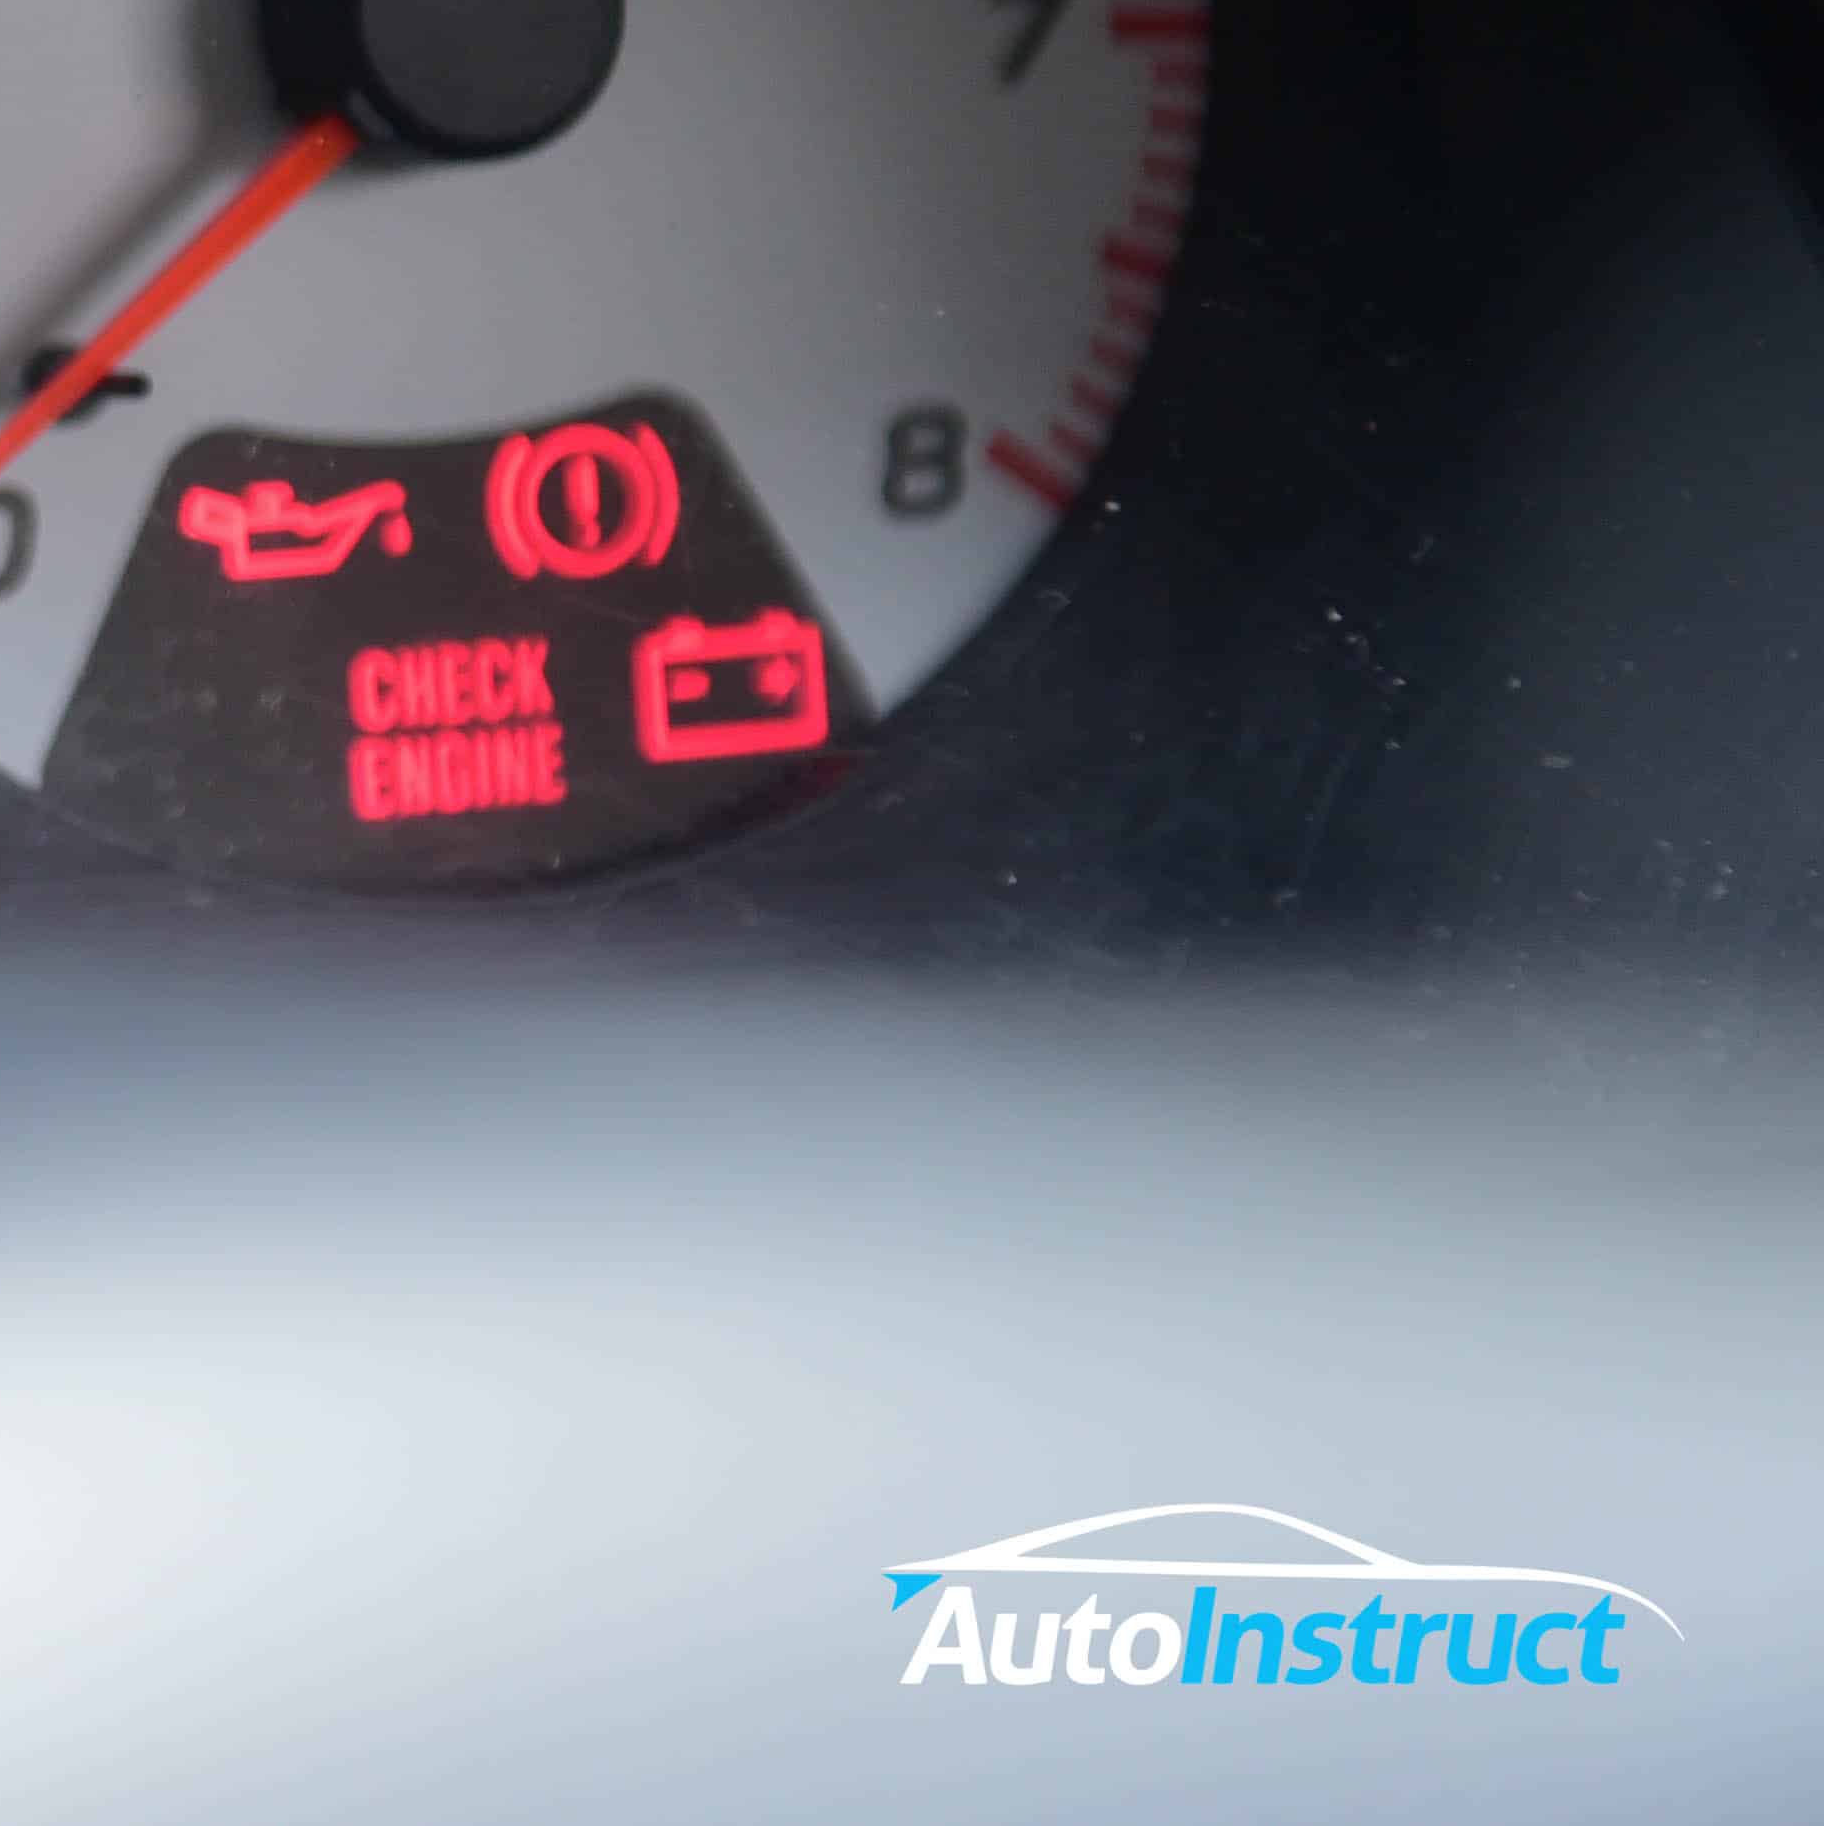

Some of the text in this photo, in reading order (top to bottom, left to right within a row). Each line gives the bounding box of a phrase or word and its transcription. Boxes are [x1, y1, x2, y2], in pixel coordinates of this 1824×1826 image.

[882, 405, 967, 514] 8
[349, 637, 553, 733] CHECK
[349, 722, 567, 822] ENGINE
